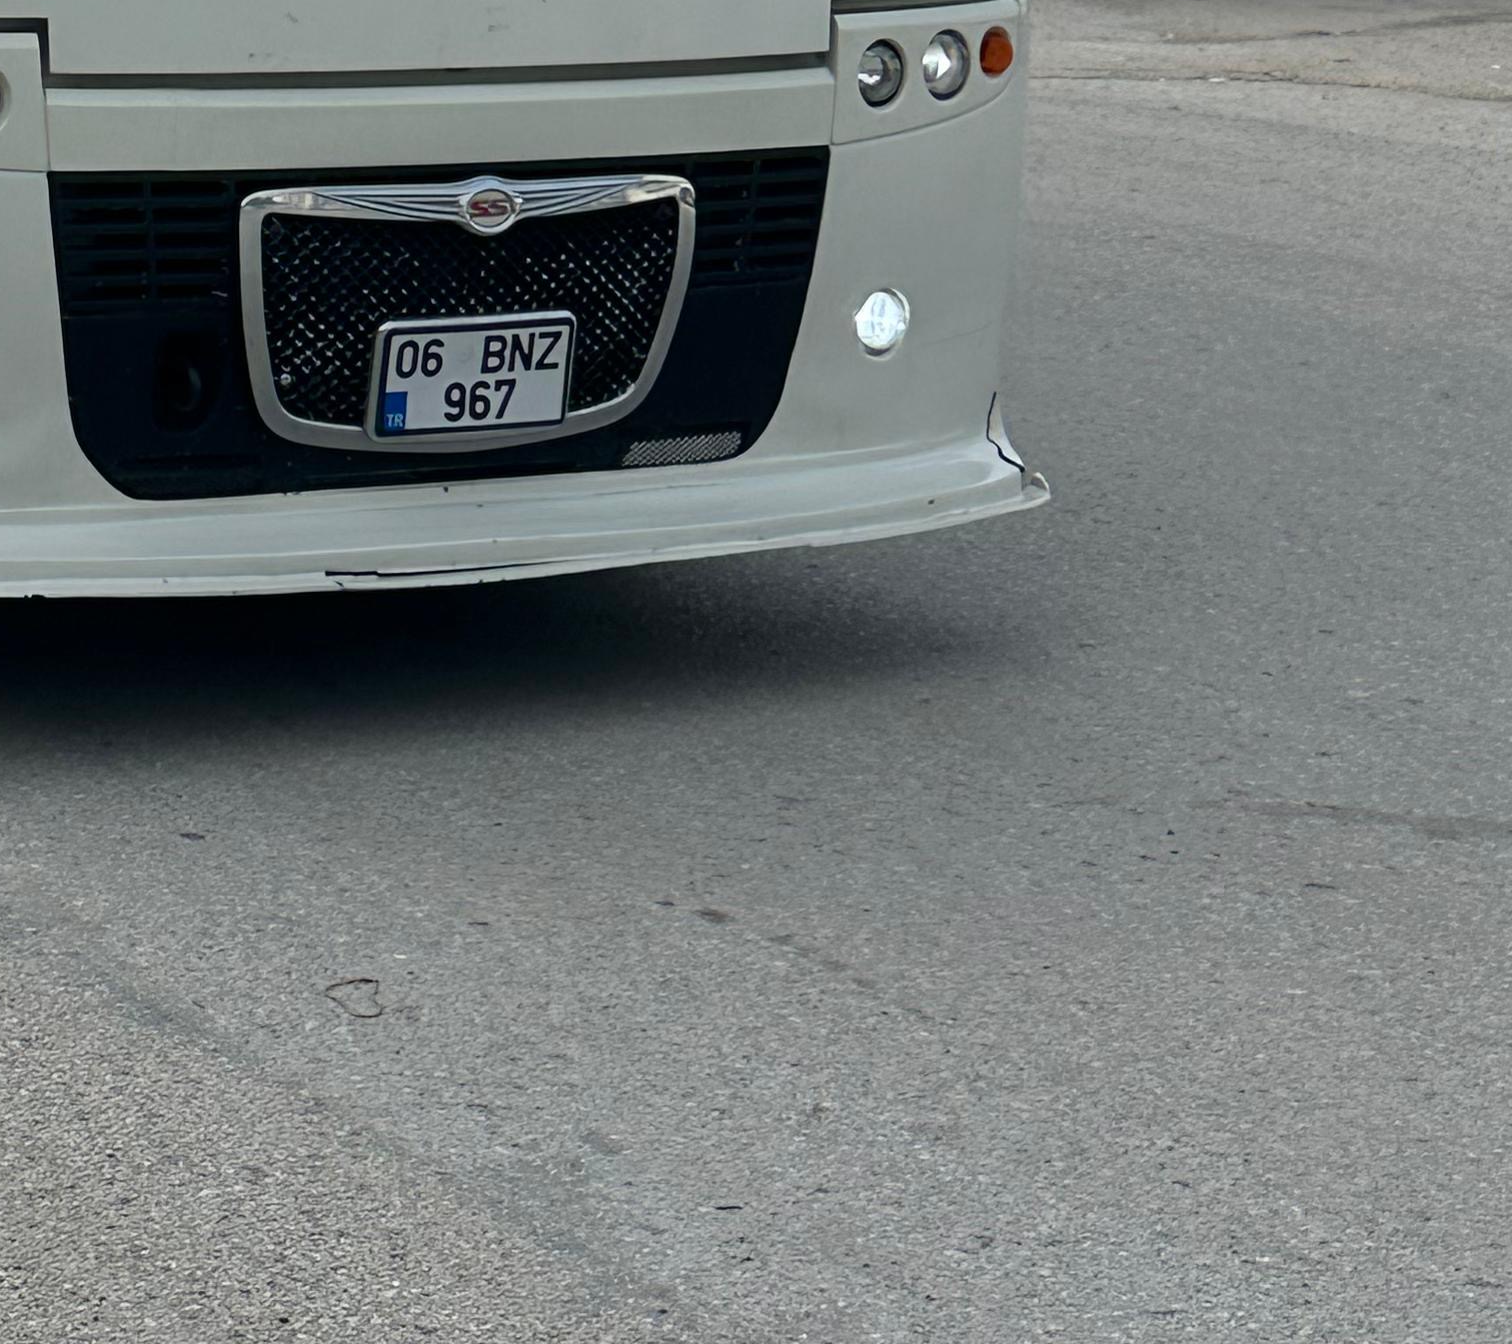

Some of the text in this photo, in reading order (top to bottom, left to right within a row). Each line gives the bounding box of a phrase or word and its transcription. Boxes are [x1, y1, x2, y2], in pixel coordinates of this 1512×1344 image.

[395, 331, 563, 378] 06 BNZ
[386, 413, 405, 427] TR
[444, 378, 517, 422] 967
